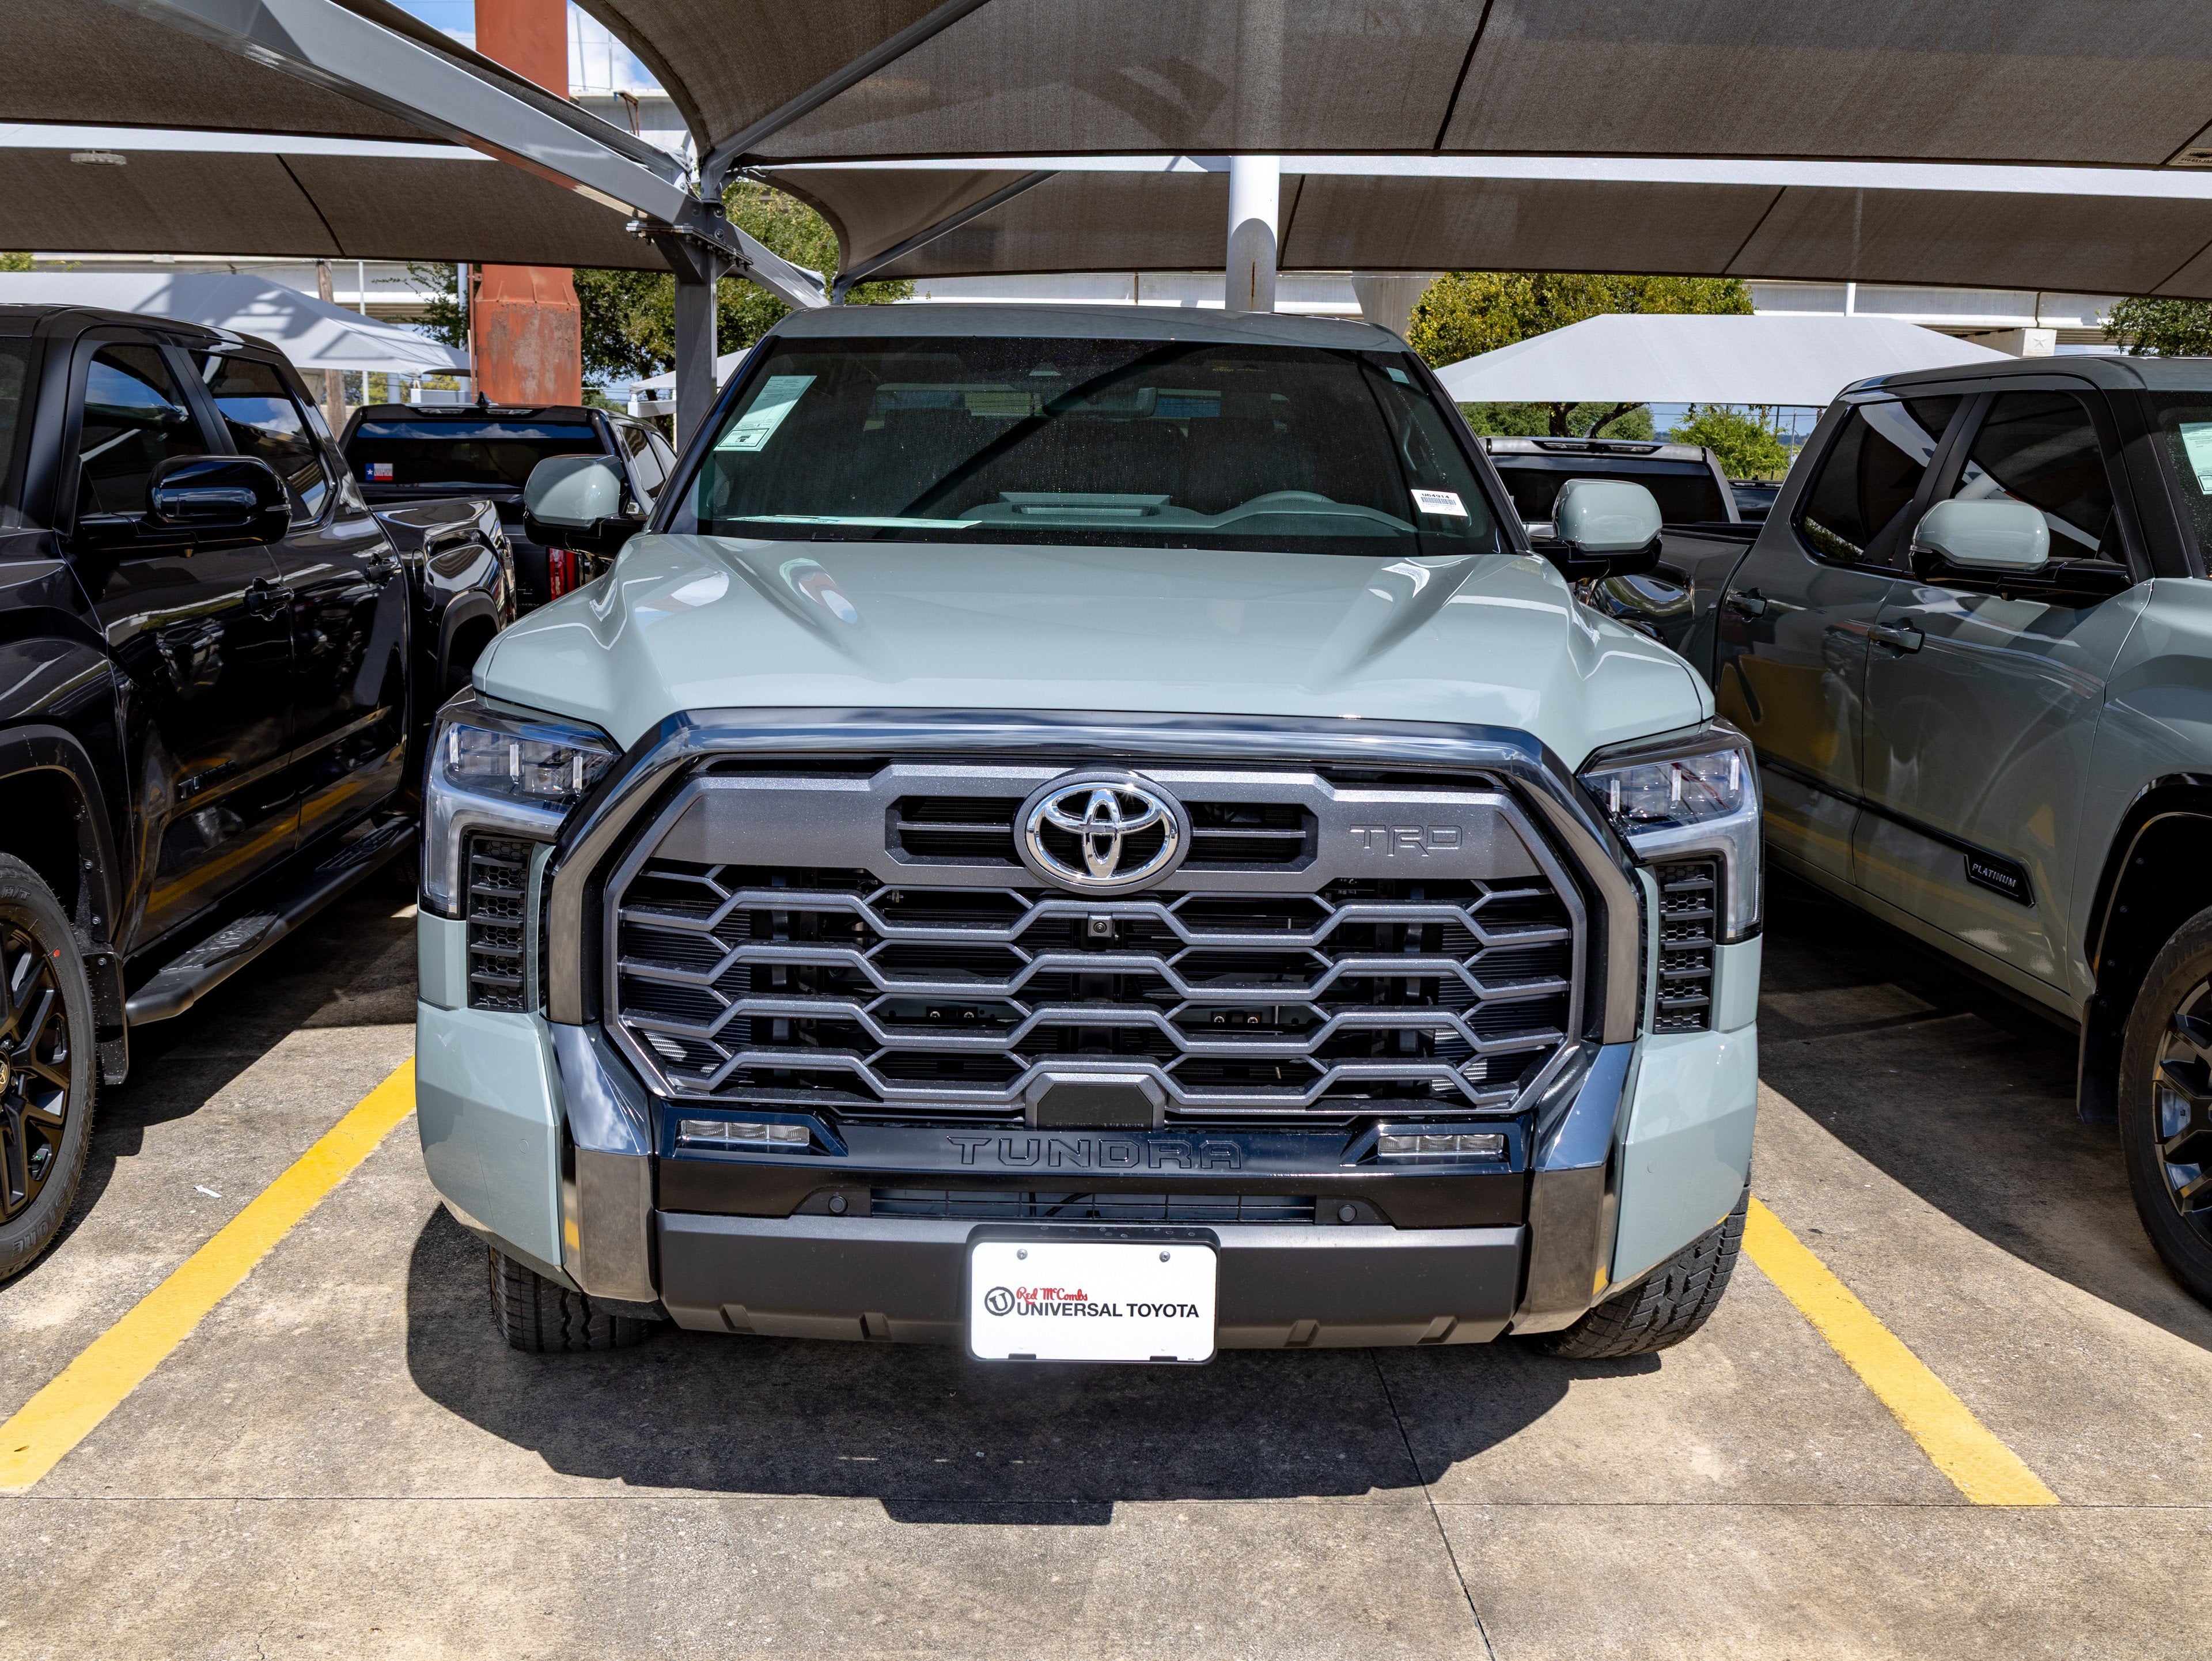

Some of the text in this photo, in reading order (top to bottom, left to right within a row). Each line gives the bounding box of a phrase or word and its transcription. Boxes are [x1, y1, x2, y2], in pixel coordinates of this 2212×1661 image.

[1350, 824, 1463, 857] TRD
[1972, 863, 2016, 887] PLATINUM
[946, 1136, 1241, 1170] TUNDRA
[1016, 1287, 1088, 1304] Red McCombs
[1017, 1302, 1199, 1318] UNIVERSAL TOYOTA
